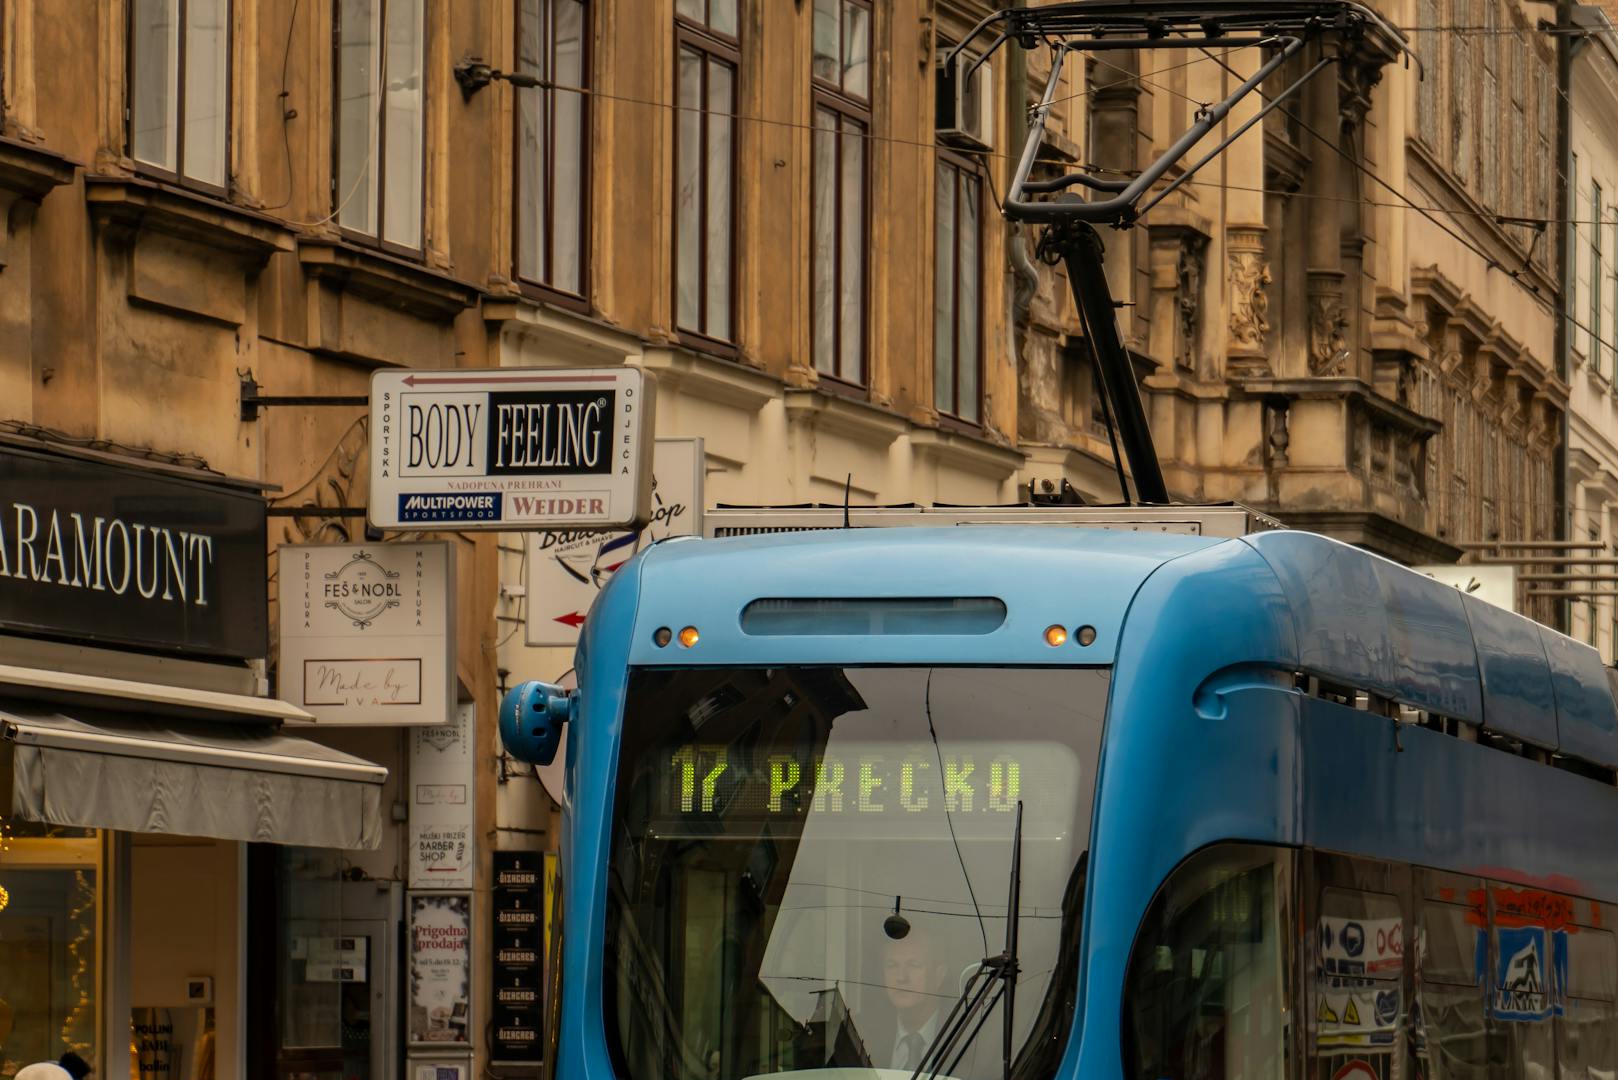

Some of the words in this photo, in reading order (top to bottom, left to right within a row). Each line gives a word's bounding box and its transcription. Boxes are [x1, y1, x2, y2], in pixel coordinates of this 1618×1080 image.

[382, 393, 391, 478] SPORTSKA
[407, 403, 481, 469] BODY
[447, 480, 505, 491] NADOPUNA
[507, 479, 562, 489] PREHRANI
[404, 495, 494, 510] MULTIPOWER
[512, 497, 605, 516] WEIDER
[404, 510, 494, 519] SPORTSFOOD
[361, 582, 402, 597] NOBL
[670, 744, 729, 812] 17
[420, 841, 454, 851] BARBER
[420, 852, 446, 862] SHOP
[416, 925, 467, 939] Prigodna
[418, 938, 464, 952] prodaja
